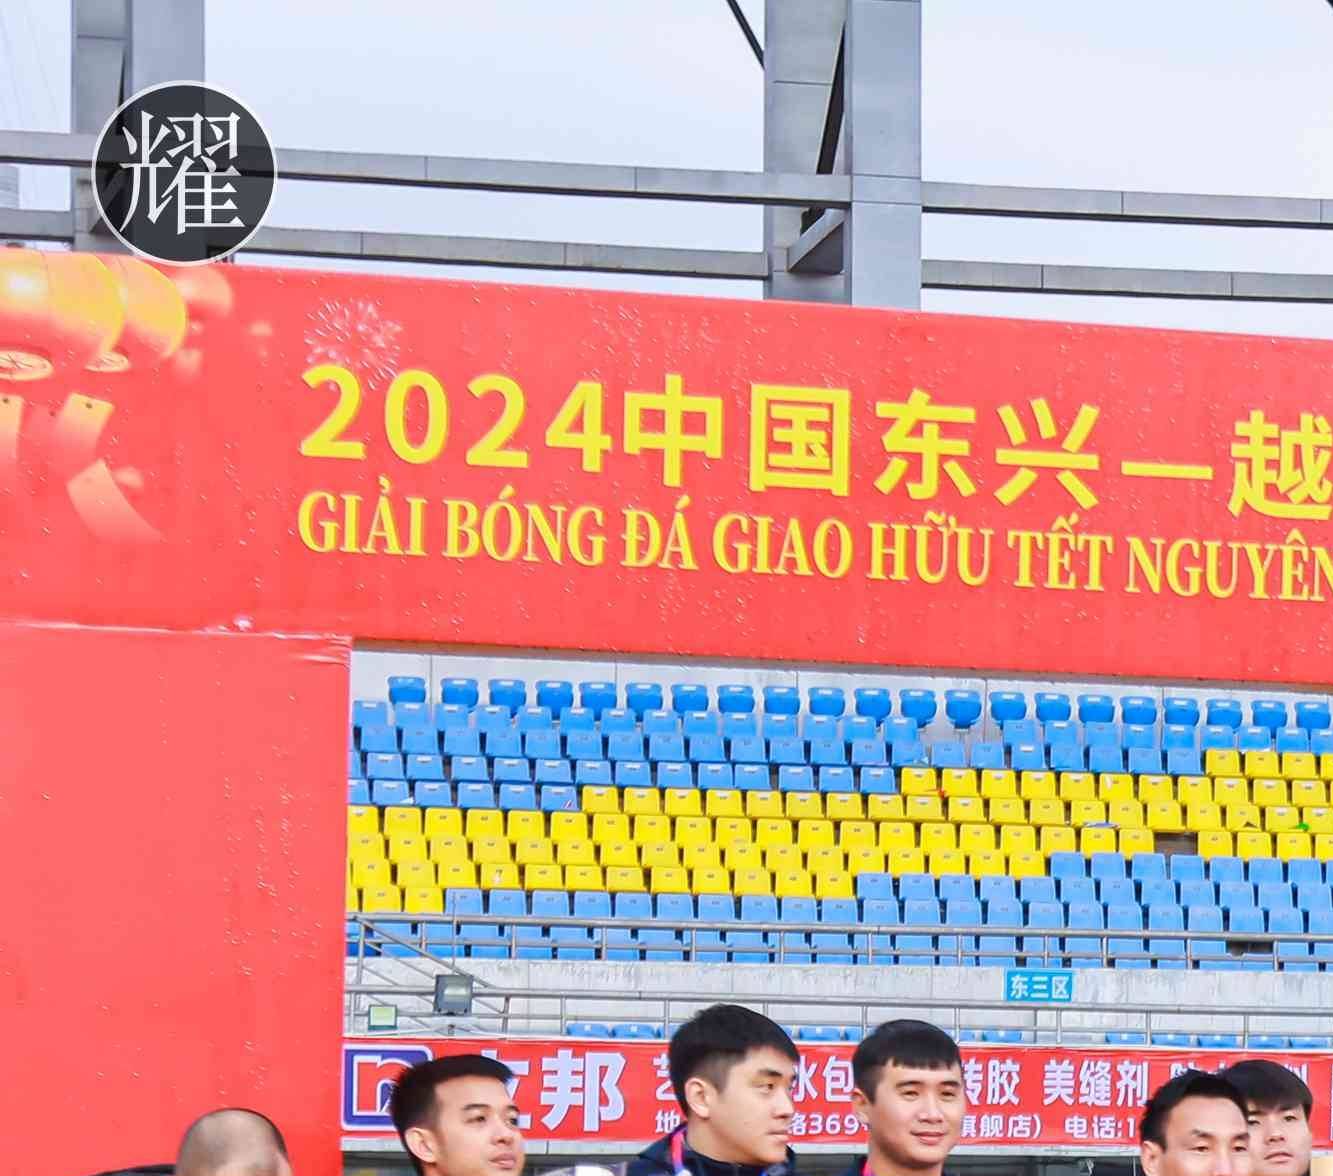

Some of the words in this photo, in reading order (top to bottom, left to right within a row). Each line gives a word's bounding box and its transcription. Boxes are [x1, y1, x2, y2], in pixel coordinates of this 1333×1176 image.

[299, 478, 426, 557] GIẢI
[444, 486, 605, 566] BÓNG
[621, 495, 697, 570] ĐÁ
[713, 515, 853, 579] GIAO
[867, 510, 994, 586] HỮU
[1008, 510, 1112, 591] TẾT
[1010, 975, 1071, 999] 东三区
[1041, 1058, 1150, 1107] 美缝剂
